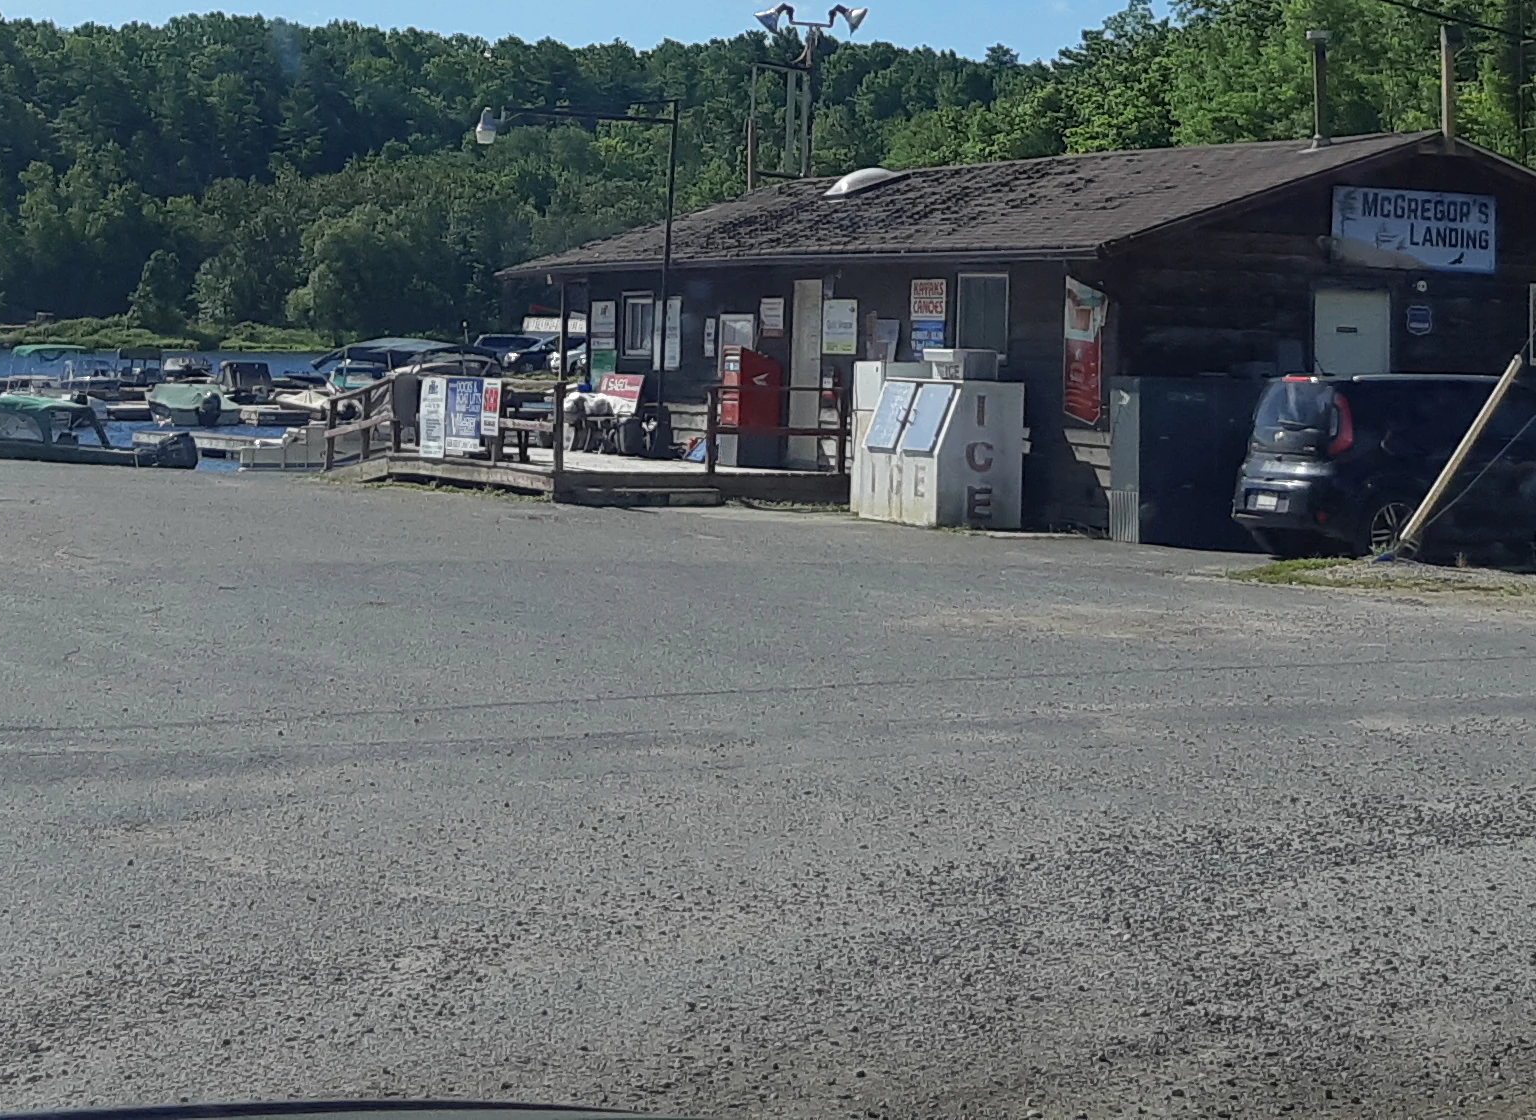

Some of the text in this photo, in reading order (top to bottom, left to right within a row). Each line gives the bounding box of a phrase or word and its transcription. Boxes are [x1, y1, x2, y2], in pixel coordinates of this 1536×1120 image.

[1362, 192, 1489, 224] McGREGOR'S
[1409, 223, 1490, 250] LANDING
[913, 300, 944, 314] CANOES
[945, 364, 961, 379] ICE
[966, 394, 994, 520] ICE
